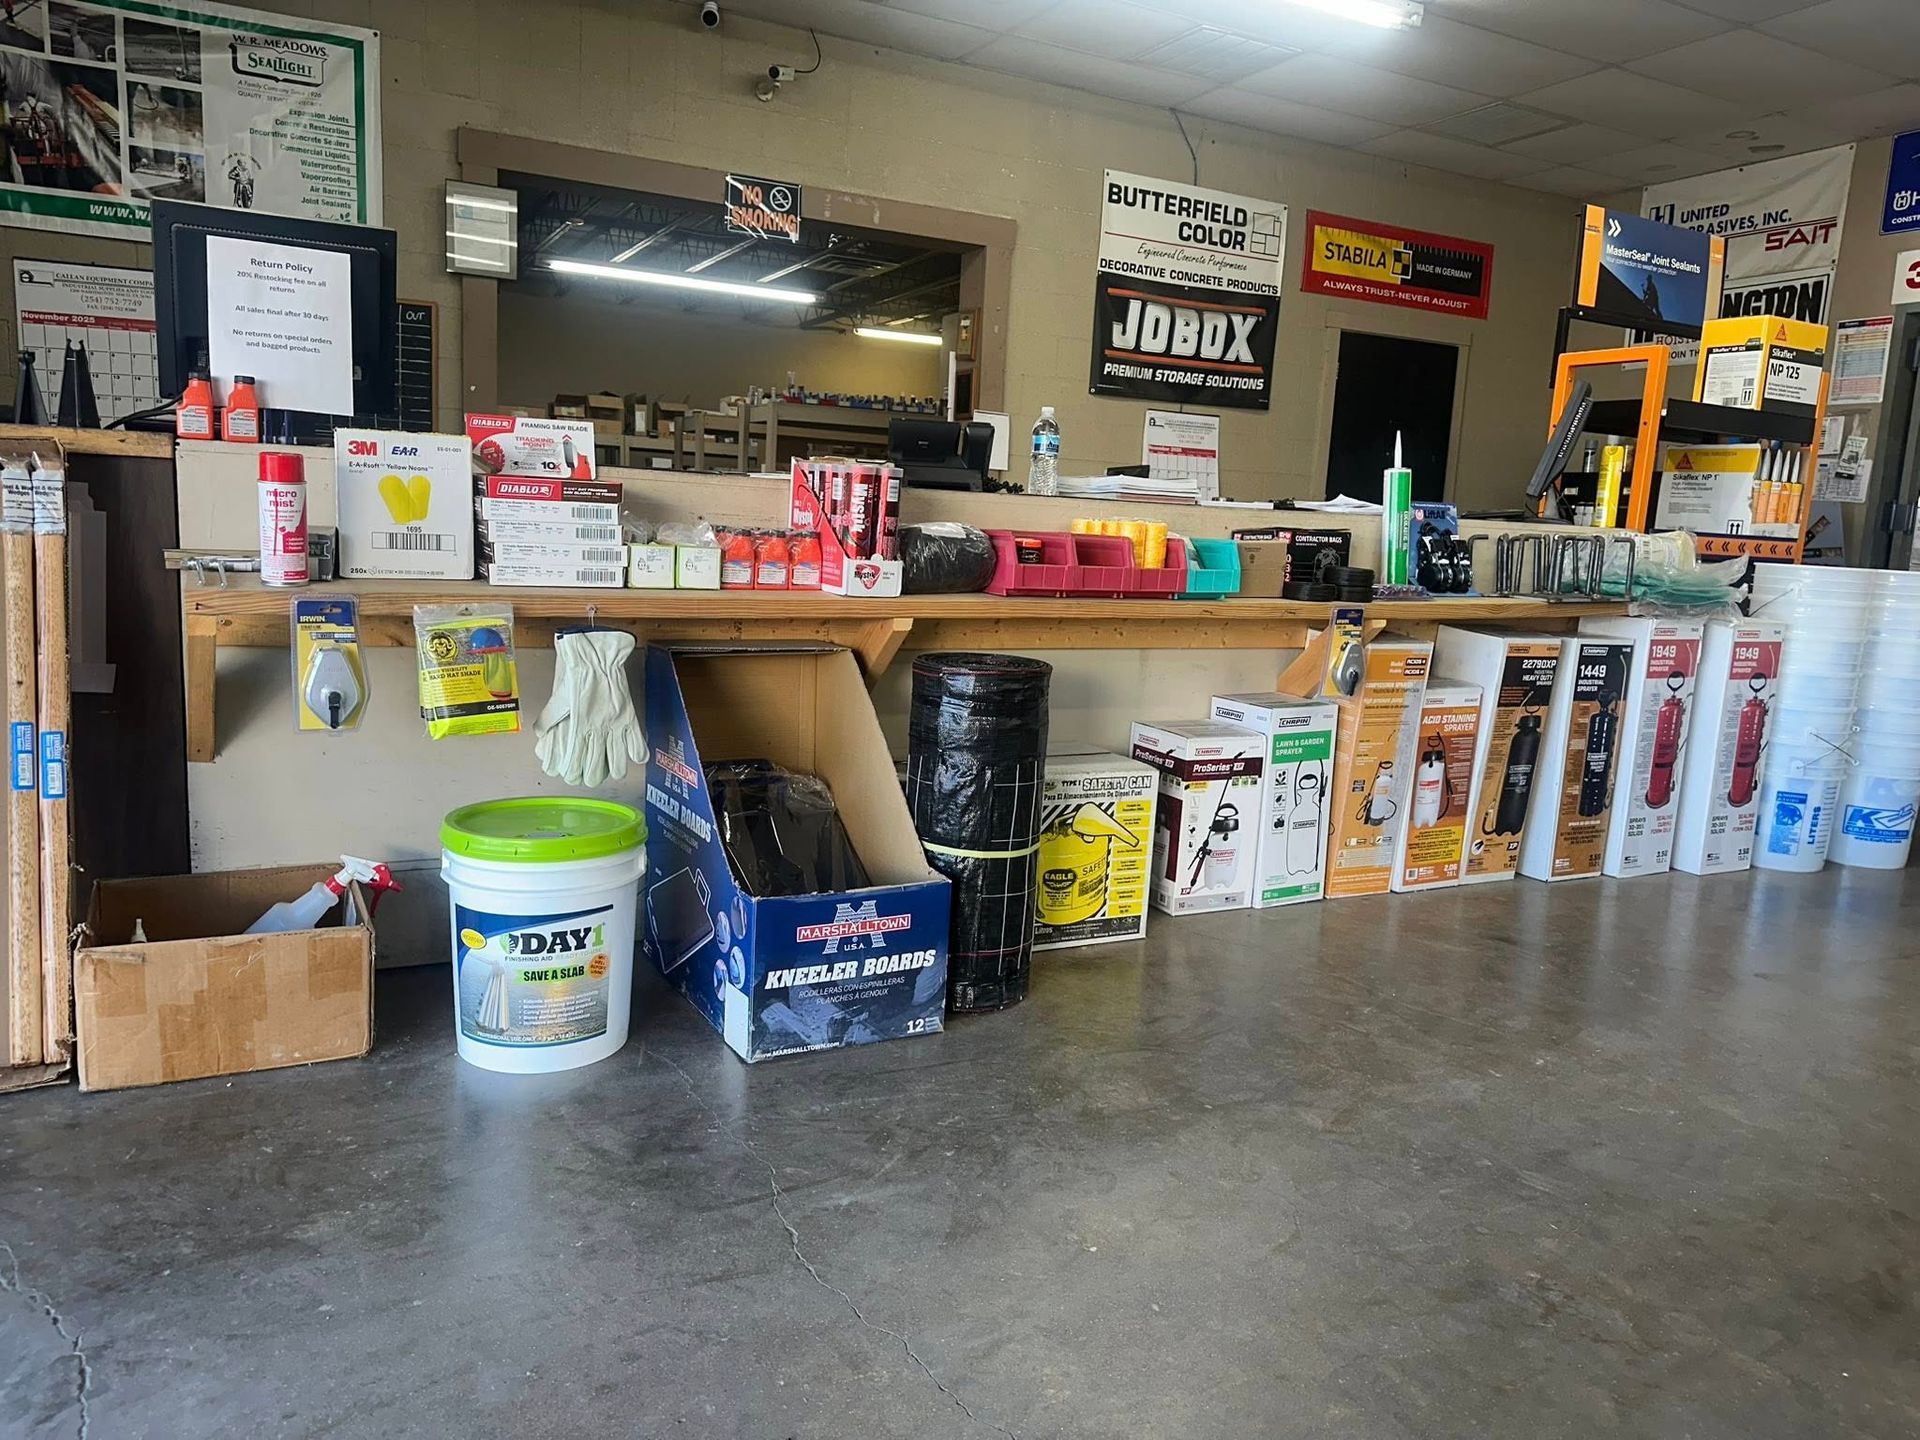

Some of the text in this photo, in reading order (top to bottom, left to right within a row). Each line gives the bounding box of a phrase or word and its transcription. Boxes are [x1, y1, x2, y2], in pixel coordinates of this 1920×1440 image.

[264, 39, 326, 57] MEADOWS
[328, 112, 349, 124] Joints
[309, 123, 350, 136] Restoration
[325, 151, 350, 161] Liquids
[300, 159, 351, 173] Waterproofing
[301, 172, 351, 186] Vaporproofing
[309, 185, 351, 197] Air Barriers
[742, 184, 762, 206] NO
[301, 197, 351, 209] Joint Sealants
[1108, 182, 1247, 227] BUTTERFIELD
[731, 206, 797, 233] SMOKING
[1681, 203, 1730, 224] UNITED
[1762, 209, 1792, 225] INC.
[1179, 222, 1246, 251] COLOR
[1765, 222, 1837, 251] SAIT
[1137, 243, 1248, 271] Engineered Concrete Performance
[1325, 242, 1386, 269] STABILA
[250, 258, 313, 274] Return Policy
[1652, 255, 1670, 267] Joint
[1671, 258, 1701, 273] Sealants
[237, 270, 252, 278] 20%
[254, 272, 293, 285] Restocking
[1100, 258, 1278, 295] DECORATIVE CONCRETE PRODUCTS
[1416, 264, 1472, 279] MADE IN GERMANY
[86, 275, 126, 284] EQUIPMENT
[269, 286, 295, 294] returns
[1323, 280, 1363, 293] ALWAYS
[1365, 286, 1430, 303] TRUST-NEVER
[22, 312, 69, 321] November
[246, 306, 265, 314] sales
[266, 308, 283, 316] final
[303, 311, 311, 319] 30
[313, 312, 329, 322] days
[245, 330, 272, 339] returns
[284, 334, 308, 344] special
[310, 337, 333, 345] orders
[1112, 299, 1258, 363] JOBOX
[261, 342, 288, 350] bagged
[289, 343, 321, 354] products
[1103, 363, 1264, 390] PREMIUM STORAGE SOLUTIONS
[1770, 362, 1800, 380] NP 125
[473, 418, 502, 427] DIABLO
[521, 422, 551, 430] FRAMING
[348, 440, 377, 456] 3M
[266, 489, 297, 498] micro
[500, 484, 539, 493] DIABLO
[269, 499, 295, 508] mist
[1295, 535, 1328, 543] CONTRACTOR
[854, 570, 876, 580] Mystik
[299, 615, 325, 623] IRWIN
[1652, 645, 1676, 658] 1949
[1735, 648, 1759, 660] 1949
[1522, 660, 1556, 669] 22790XP
[1580, 665, 1606, 677] 1449
[1217, 708, 1243, 720] CHAPIN
[1422, 714, 1476, 724] ACID STAINING
[1281, 717, 1309, 727] CHAPIN
[1443, 723, 1474, 732] SPRAYER
[1275, 739, 1293, 748] LAWN
[1300, 737, 1324, 747] GARDEN
[1134, 750, 1164, 765] ProSeries
[1197, 748, 1222, 756] CHAPIN
[1275, 748, 1302, 756] SPRAYER
[1193, 763, 1230, 772] ProSeries
[1083, 777, 1127, 791] SAFETY
[1129, 775, 1152, 789] CAN
[646, 784, 679, 822] KNEELER
[681, 805, 711, 843] BOARDS
[1807, 806, 1821, 845] LITERS
[1181, 887, 1191, 895] XP
[800, 917, 908, 939] MARSHALLTOWN
[524, 966, 585, 982] SAVE A SLAB
[765, 949, 936, 989] KNEELER BOARDS
[799, 985, 843, 998] RODILLERAS
[859, 976, 905, 990] ESPINILLERAS
[860, 988, 889, 998] GENOUX
[907, 1019, 924, 1033] 12
[753, 1041, 840, 1060] www.MARSHALLTOWN.com
